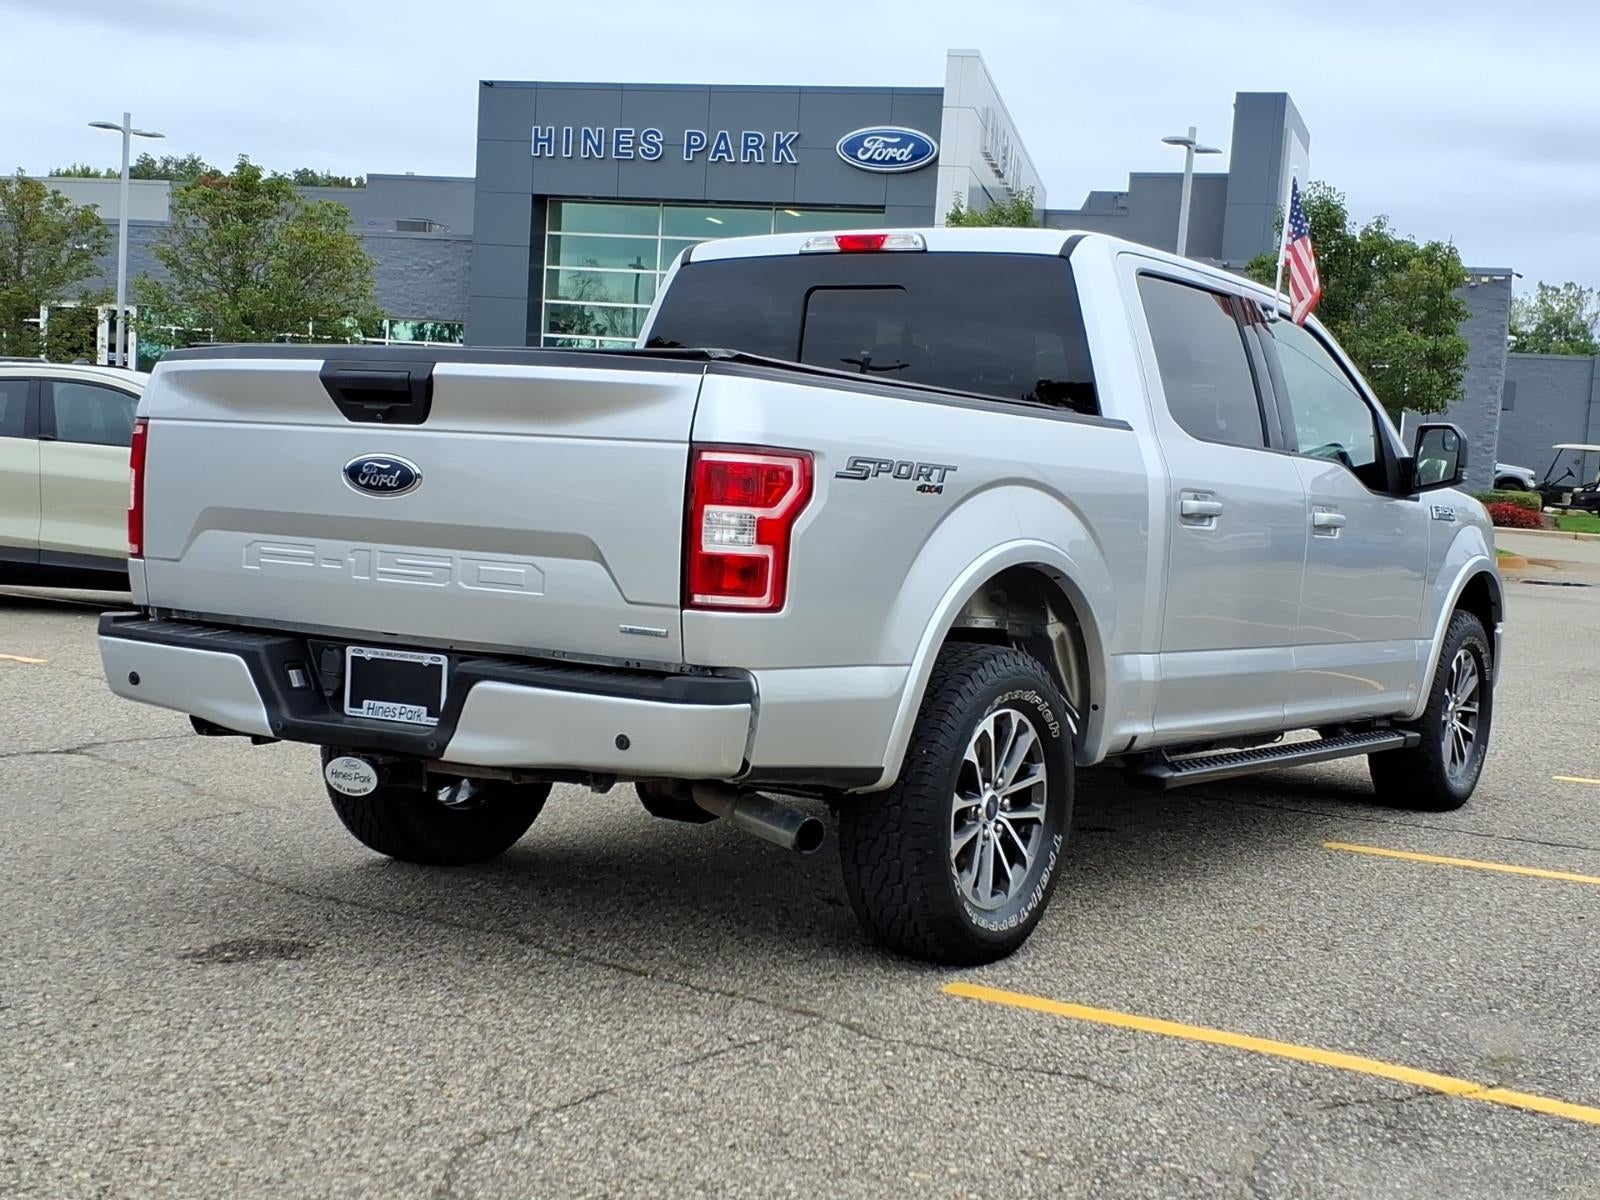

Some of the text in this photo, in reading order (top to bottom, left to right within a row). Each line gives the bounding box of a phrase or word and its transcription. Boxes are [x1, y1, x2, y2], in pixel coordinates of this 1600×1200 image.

[531, 125, 800, 165] HINES PARK
[857, 135, 915, 163] Ford
[357, 461, 401, 488] Ford
[834, 455, 958, 484] SPORT
[242, 539, 545, 596] F-150
[366, 702, 424, 723] Hines Park
[331, 768, 372, 784] Hines Park
